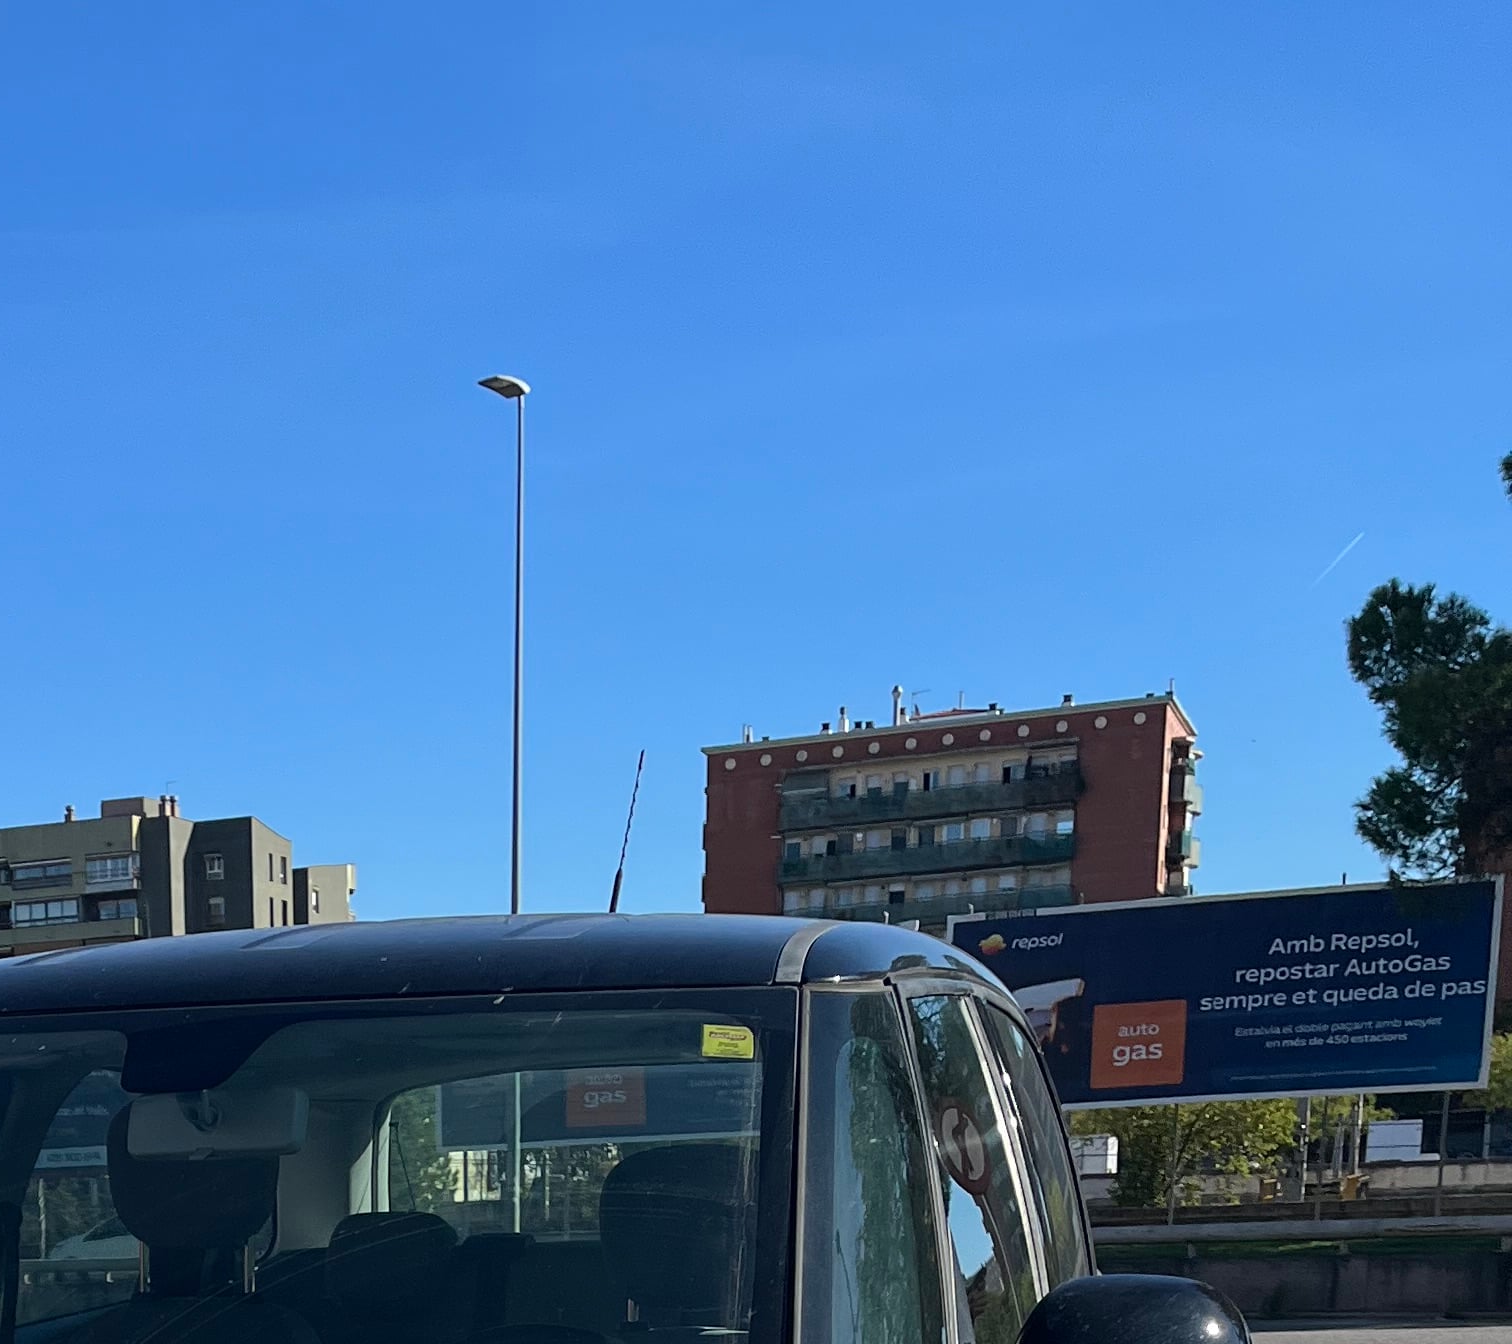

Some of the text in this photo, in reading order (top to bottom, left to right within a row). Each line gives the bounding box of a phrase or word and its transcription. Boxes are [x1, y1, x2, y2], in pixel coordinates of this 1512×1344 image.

[1011, 933, 1065, 951] repsol
[1268, 928, 1420, 955] Amb Repsol,
[1235, 954, 1451, 985] repostar AutoGas
[1199, 978, 1486, 1012] sempre et queda de pas
[1117, 1023, 1160, 1037] auto
[1234, 1025, 1281, 1037] Estalvia
[1295, 1021, 1329, 1033] doble
[1375, 1018, 1402, 1029] amb
[1265, 1032, 1408, 1048] en més de 450 estacions
[1112, 1042, 1164, 1067] gas
[584, 1090, 626, 1108] gas
